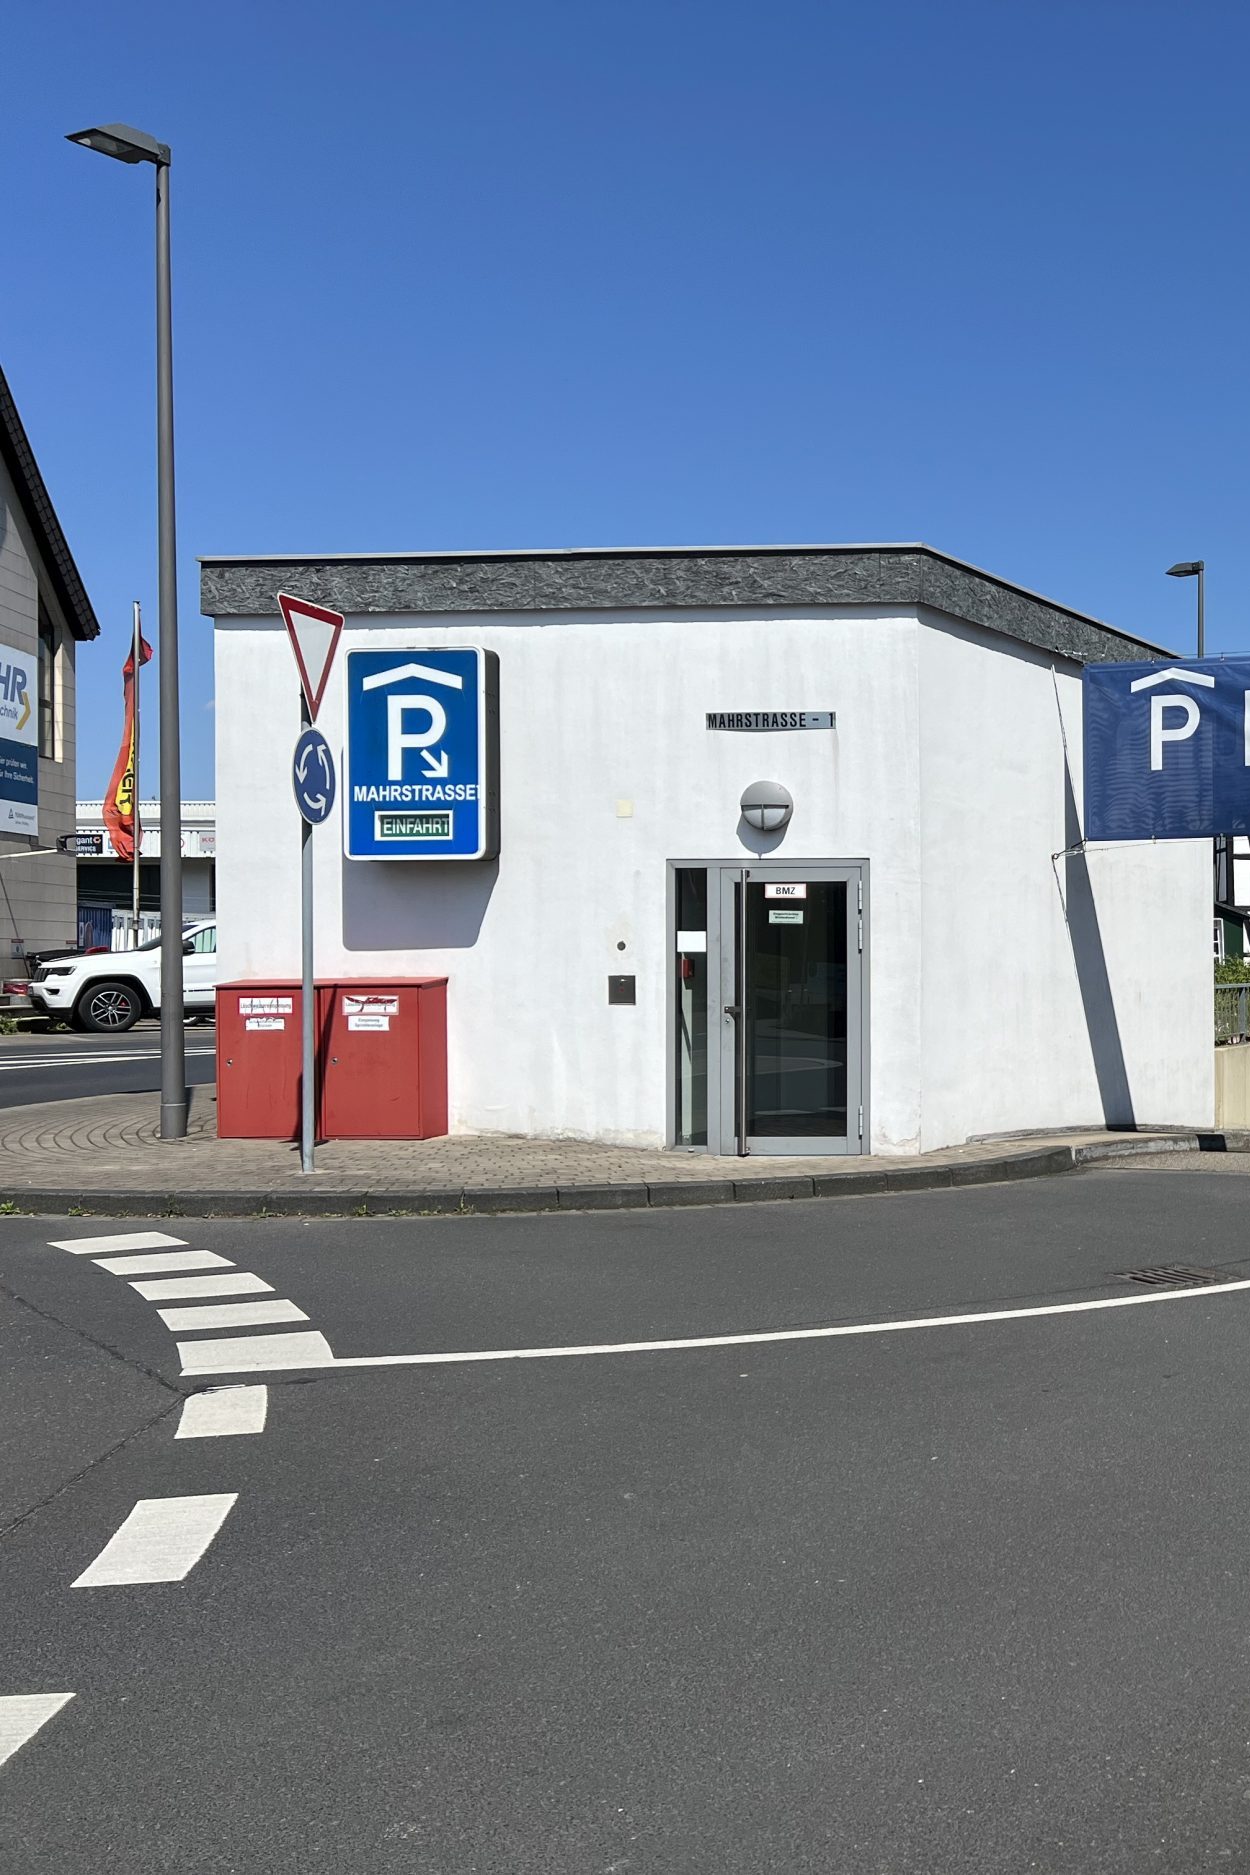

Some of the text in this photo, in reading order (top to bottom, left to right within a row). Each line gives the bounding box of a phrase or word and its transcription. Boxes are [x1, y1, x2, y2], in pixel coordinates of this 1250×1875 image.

[708, 713, 806, 728] MAHRSTRASSE
[387, 695, 446, 781] P
[1150, 695, 1200, 771] P
[354, 785, 476, 802] MAHRSTRASSE
[384, 817, 449, 834] EINFAHRT
